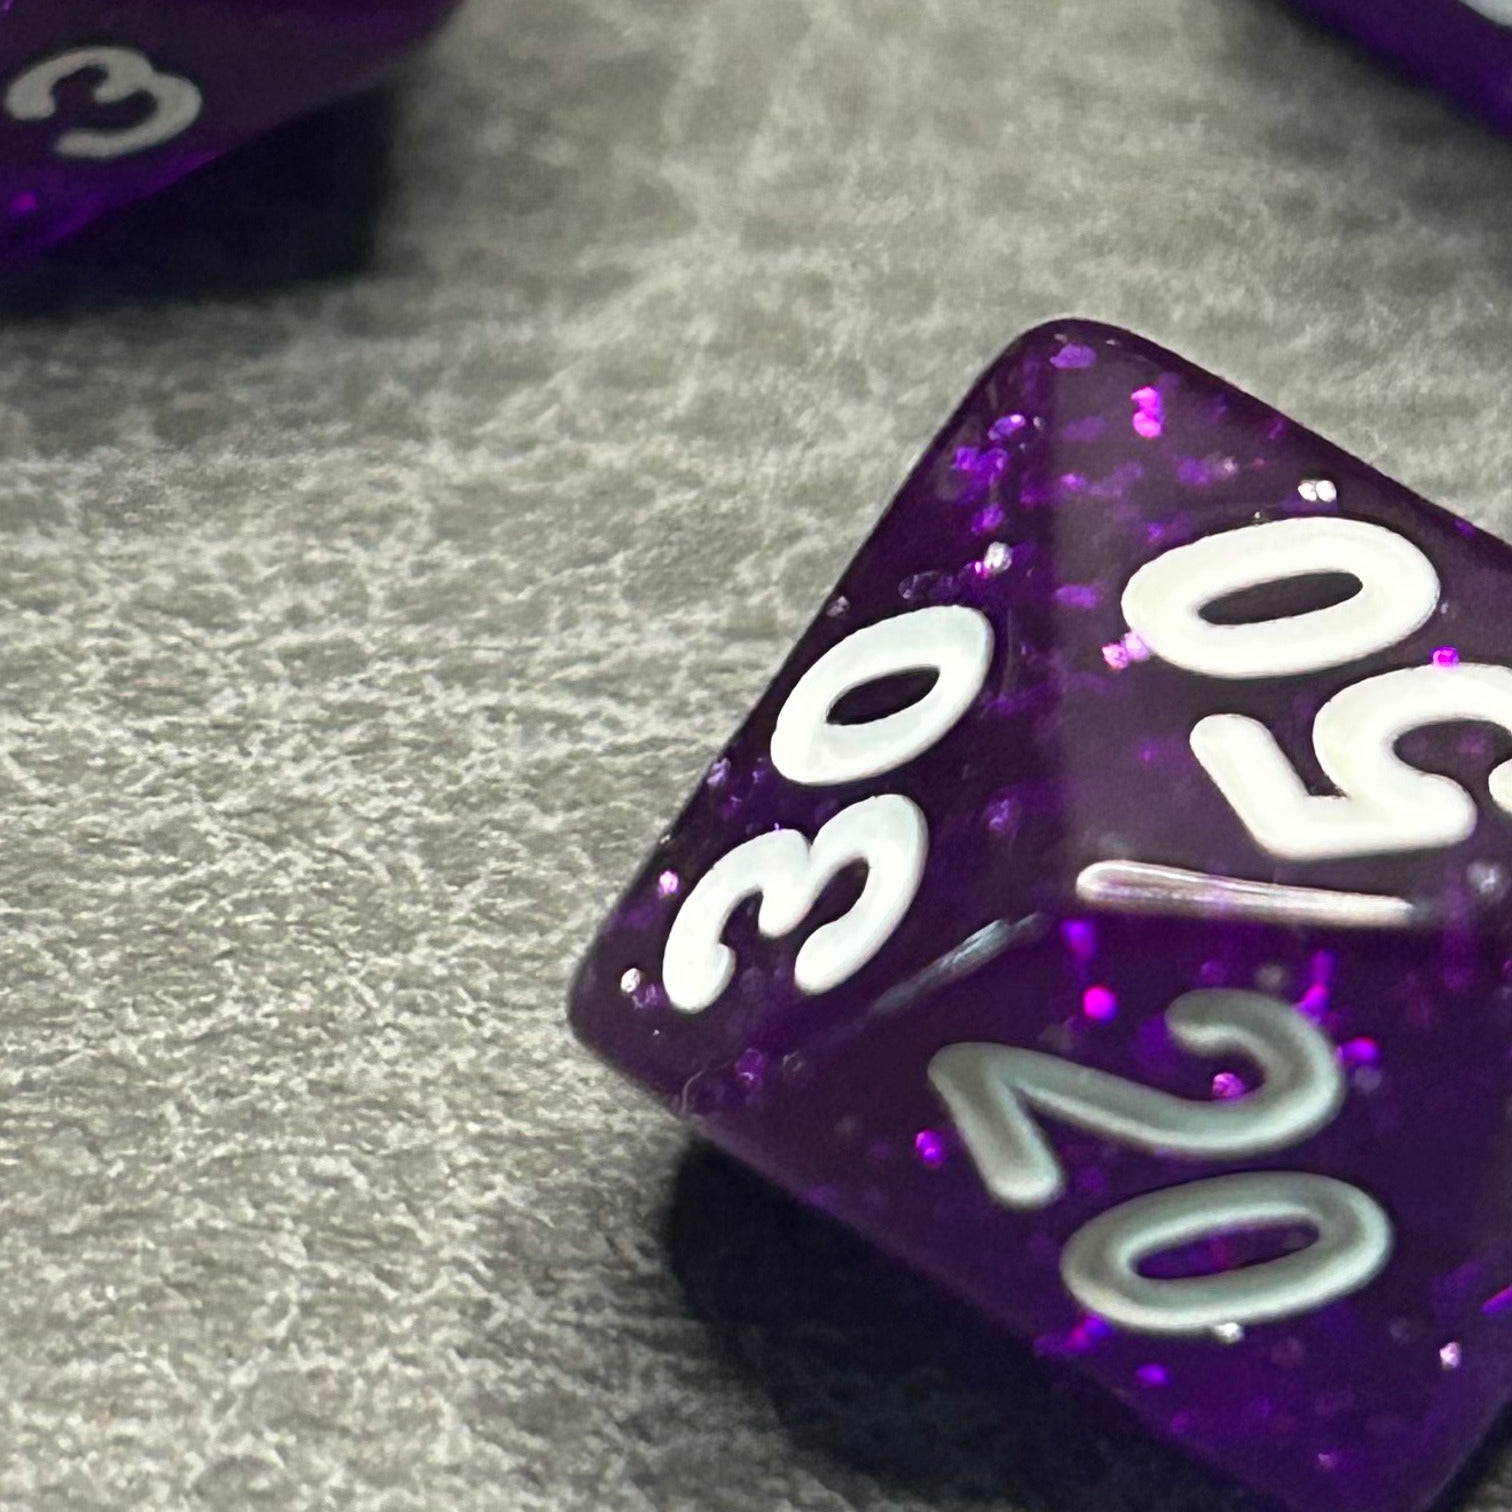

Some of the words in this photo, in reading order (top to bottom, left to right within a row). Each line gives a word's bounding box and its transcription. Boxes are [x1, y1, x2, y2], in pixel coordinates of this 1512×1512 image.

[3, 44, 204, 159] 3
[662, 605, 993, 1013] 30
[1120, 516, 1512, 860] 50
[928, 988, 1393, 1334] 20
